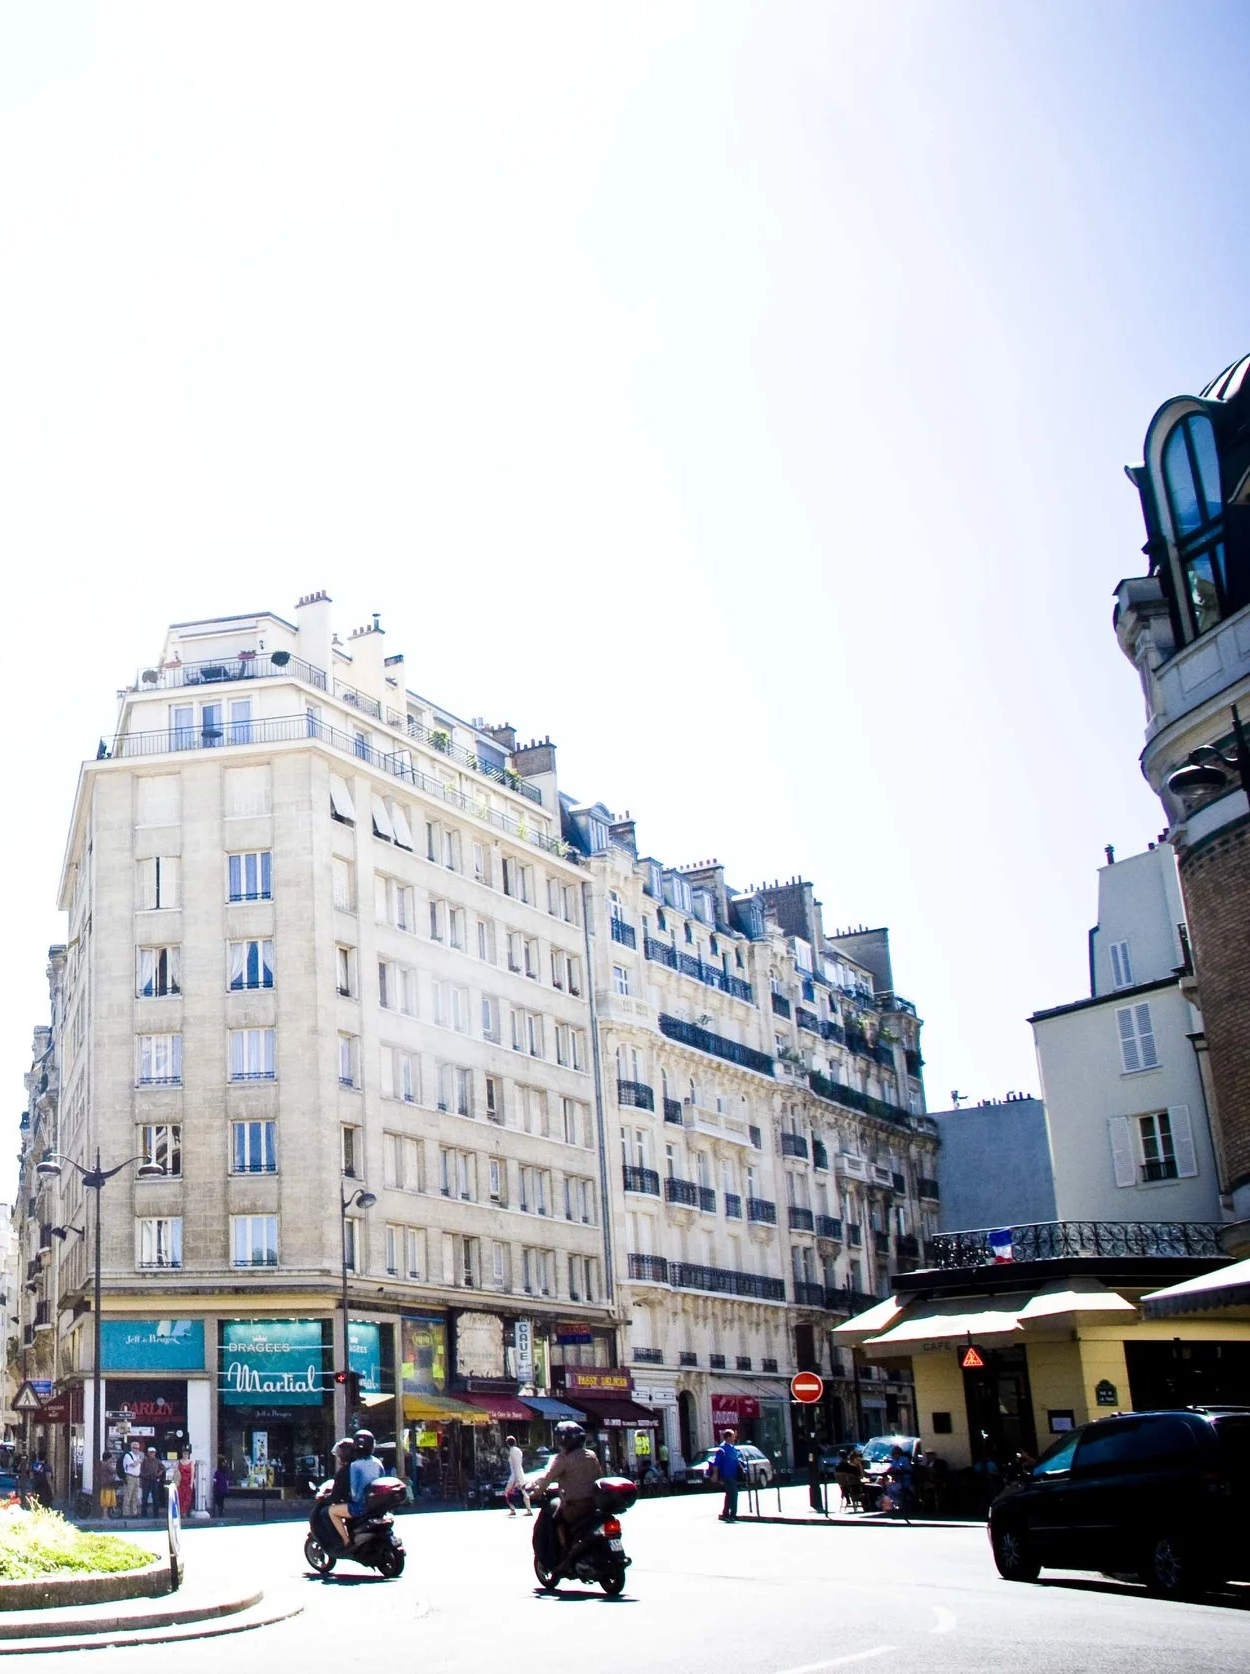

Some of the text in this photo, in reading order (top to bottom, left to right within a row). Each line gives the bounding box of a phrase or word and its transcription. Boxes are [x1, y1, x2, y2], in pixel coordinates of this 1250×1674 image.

[125, 1335, 141, 1345] Jeff
[518, 1324, 529, 1361] CAVE
[227, 1361, 326, 1393] Martial
